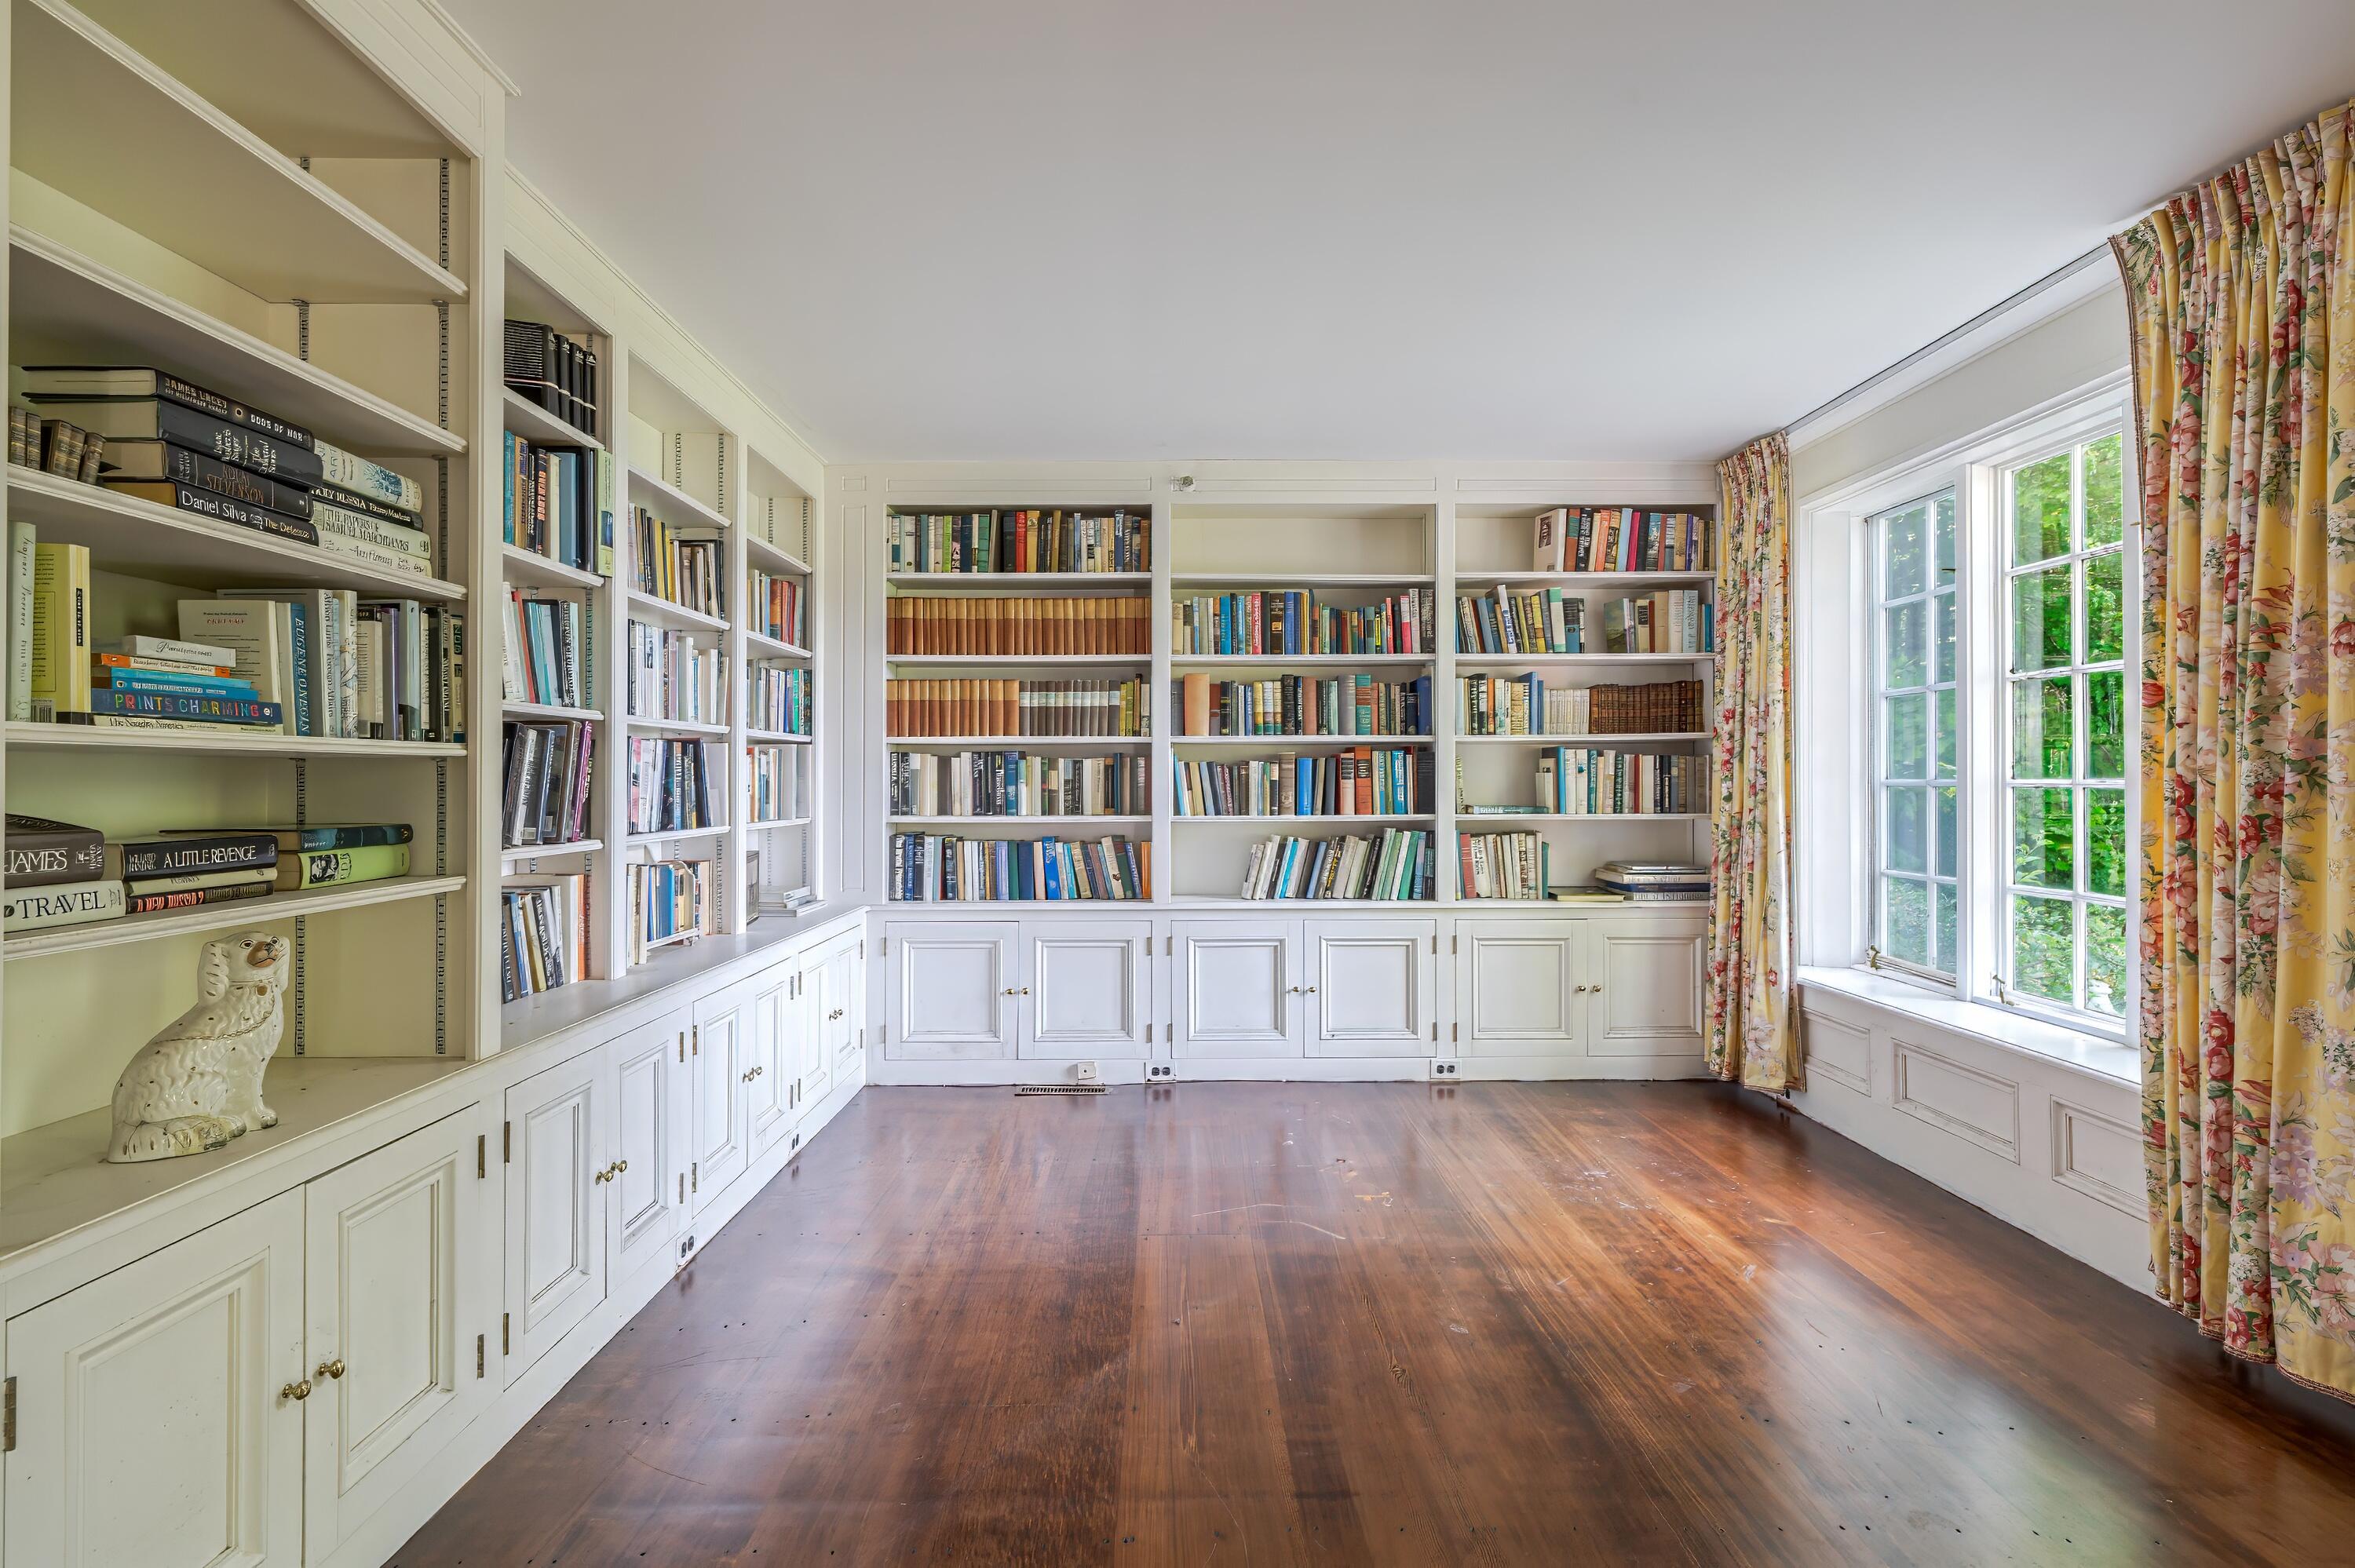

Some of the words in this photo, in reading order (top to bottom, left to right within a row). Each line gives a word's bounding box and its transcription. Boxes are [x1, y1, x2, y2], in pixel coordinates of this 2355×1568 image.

[182, 490, 219, 514] Daniel
[223, 503, 246, 522] Silva
[265, 517, 278, 530] The
[294, 618, 307, 676] EUGENE
[115, 694, 173, 713] PRINTS
[179, 698, 259, 717] CHARMING
[299, 678, 310, 731] ONEGIN
[5, 850, 67, 873] JAMES
[163, 853, 173, 869] A
[175, 849, 210, 867] LITTLE
[211, 845, 257, 863] REVENGE
[16, 891, 106, 919] TRAVEL
